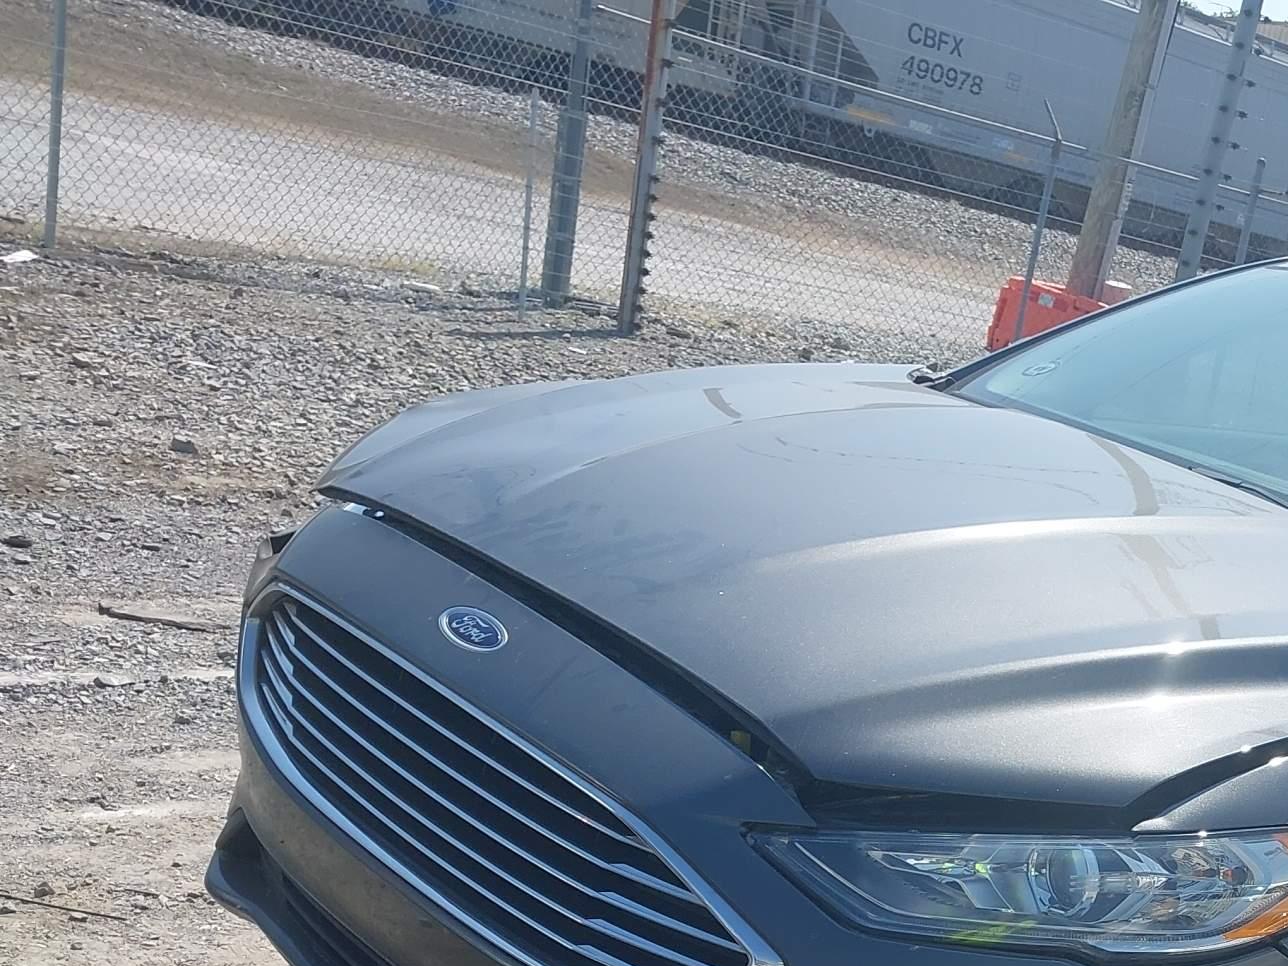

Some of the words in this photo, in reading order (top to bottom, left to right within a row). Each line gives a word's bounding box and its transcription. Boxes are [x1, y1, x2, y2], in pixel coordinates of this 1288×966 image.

[907, 22, 965, 58] CBFX
[902, 55, 984, 96] 490978
[451, 615, 494, 643] Ford
